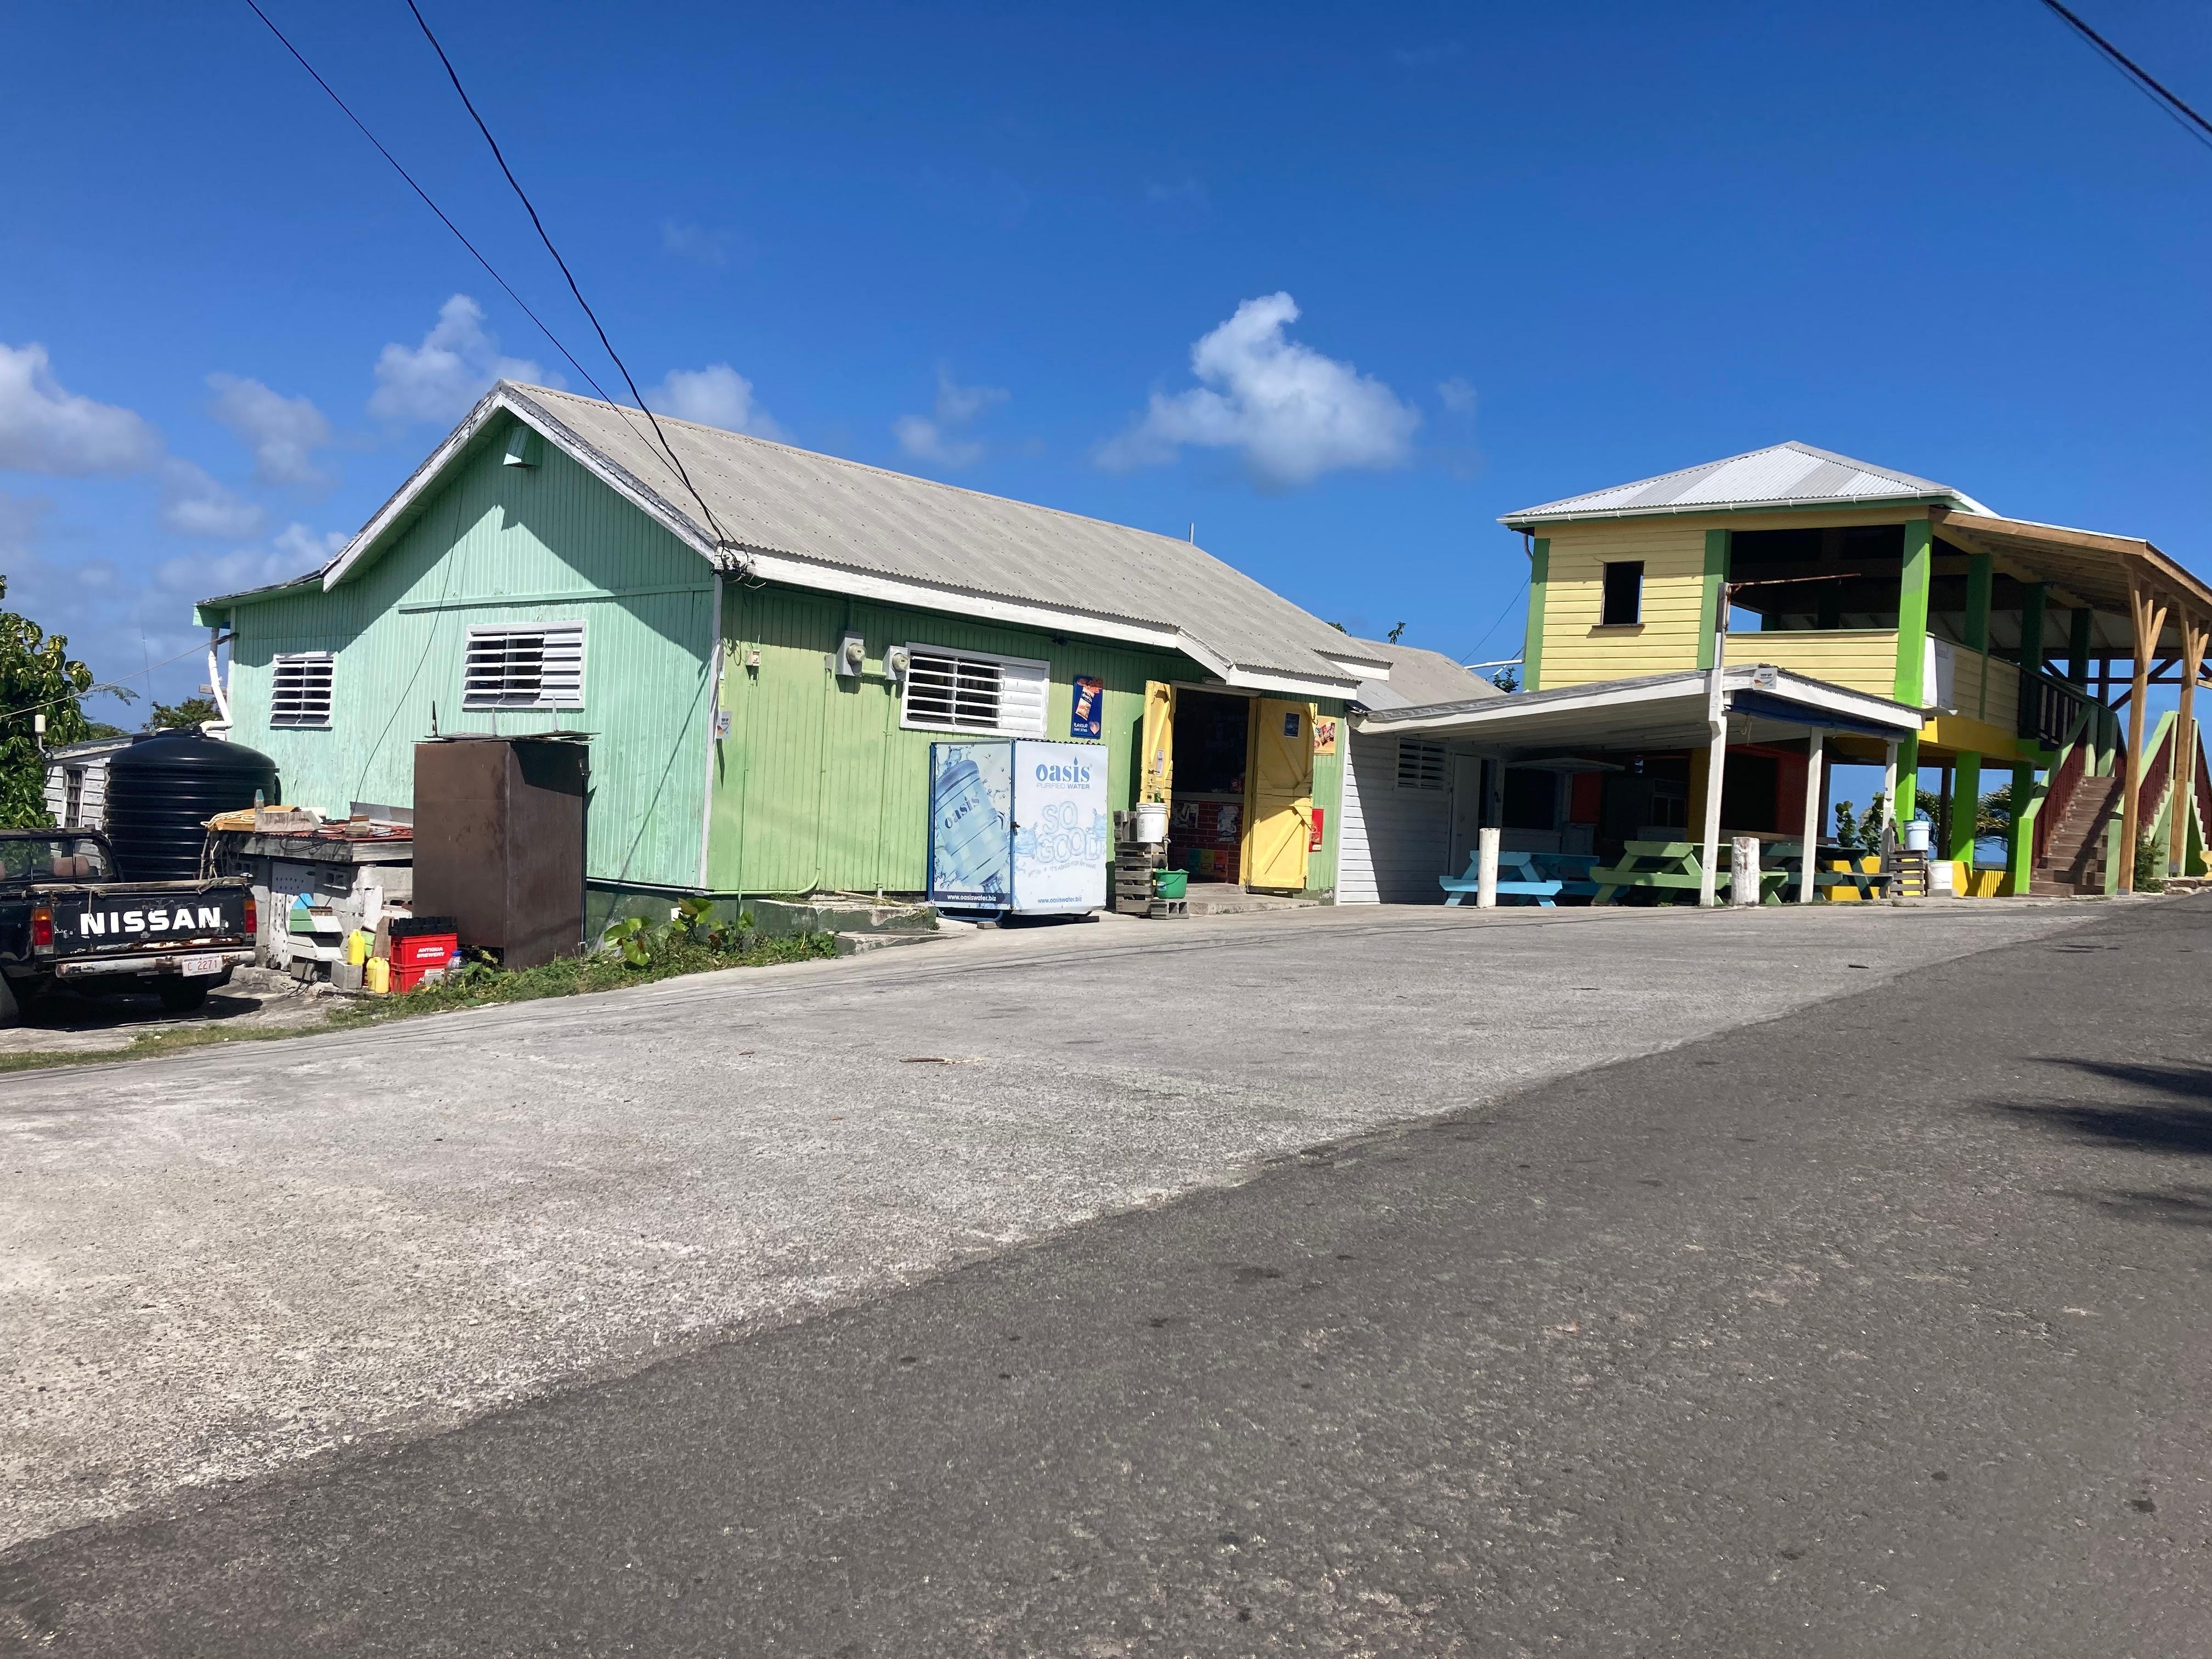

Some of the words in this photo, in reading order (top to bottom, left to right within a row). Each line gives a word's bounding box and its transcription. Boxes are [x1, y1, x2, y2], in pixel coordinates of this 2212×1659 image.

[1036, 756, 1090, 783] oasis
[945, 795, 980, 829] oasis
[1043, 800, 1078, 834] SO
[1036, 827, 1102, 864] GOOD
[1058, 862, 1071, 871] ASKED
[947, 894, 996, 902] www.oasiswater.biz
[1037, 895, 1082, 904] www.oasiswater.biz
[80, 907, 220, 935] NISSAN
[188, 962, 193, 971] C
[198, 960, 217, 970] 2271
